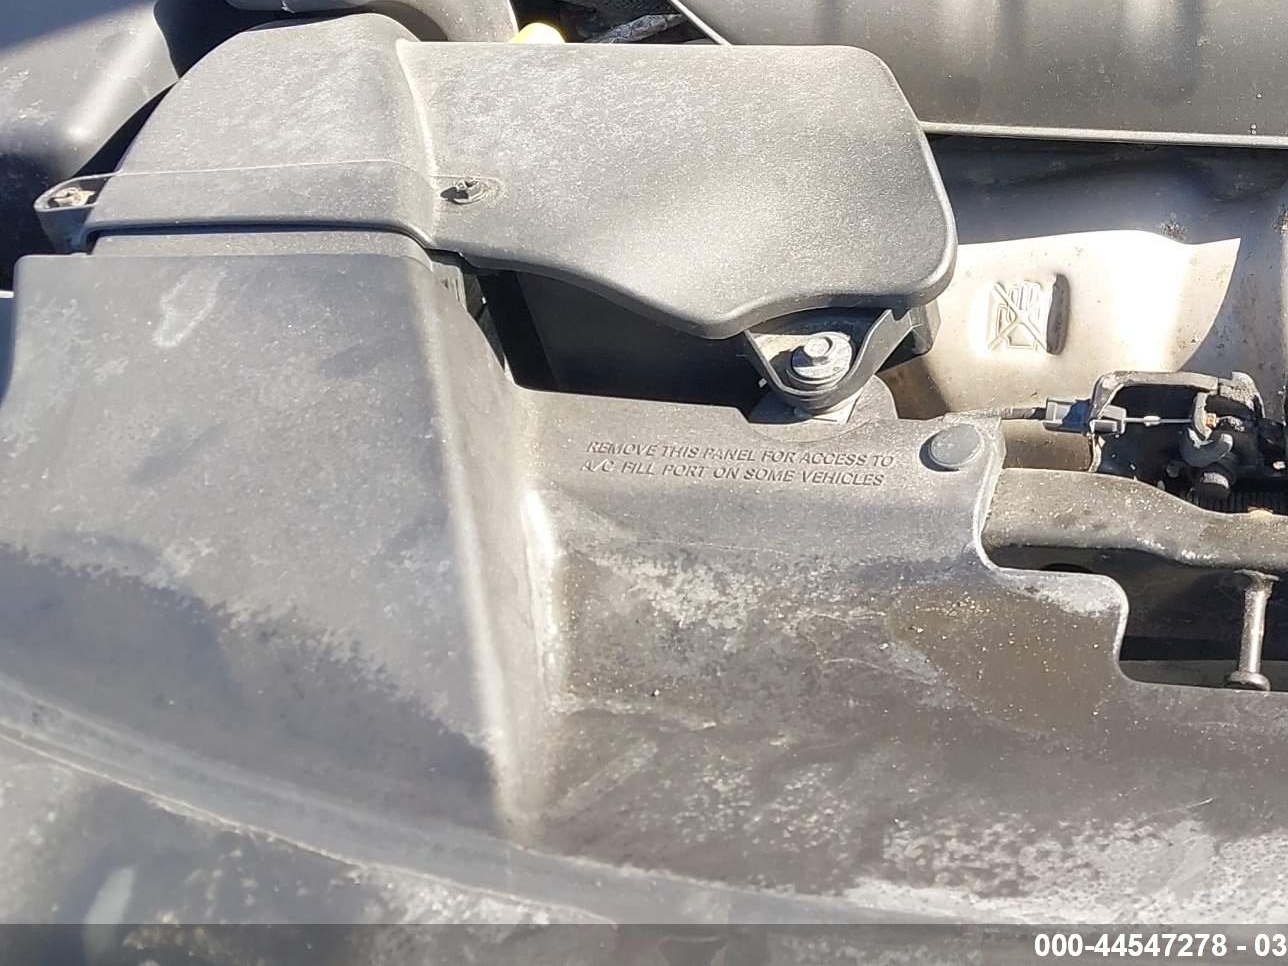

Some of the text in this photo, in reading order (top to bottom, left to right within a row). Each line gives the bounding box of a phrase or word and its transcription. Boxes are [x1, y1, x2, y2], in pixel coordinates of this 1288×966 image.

[585, 440, 895, 468] REMOVE THIS PANEL FOR ACCESS TO
[580, 459, 885, 487] A/C FILL PORT ON SOME VEHICLES
